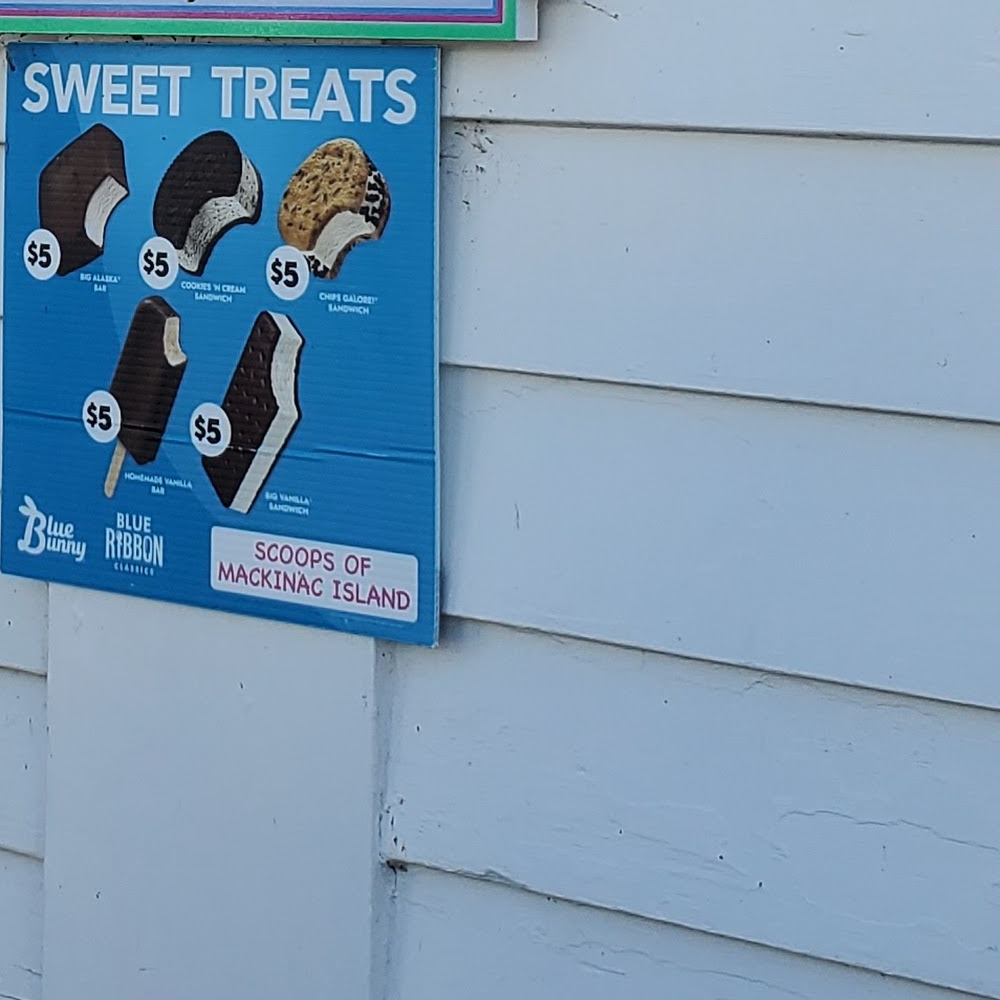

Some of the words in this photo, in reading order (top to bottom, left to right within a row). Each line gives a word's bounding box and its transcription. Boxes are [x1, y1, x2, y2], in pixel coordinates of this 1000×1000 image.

[21, 62, 191, 117] SWEET
[210, 66, 418, 124] TREATS
[27, 240, 52, 269] $5
[142, 250, 169, 279] $5
[270, 258, 300, 288] $5
[94, 284, 107, 292] BAR
[181, 280, 211, 291] COOKIES
[222, 284, 246, 294] CREAM
[195, 292, 232, 303] SANDWICH
[319, 292, 341, 302] CHIPS
[328, 303, 369, 315] SANDWICH
[86, 402, 112, 431] $5
[194, 415, 221, 444] $5
[124, 471, 163, 485] HOMEMADE
[164, 477, 193, 489] VANILLA
[151, 486, 165, 495] BAR
[265, 490, 278, 500] BIG
[268, 502, 309, 516] SANDWICH
[116, 512, 151, 533] BLUE
[105, 527, 163, 567] RIBBON
[254, 541, 335, 571] SCOOPS
[344, 554, 372, 577] OF
[114, 562, 154, 576] CLASSICS
[218, 562, 323, 597] MACKINAC
[332, 579, 411, 611] ISLAND
